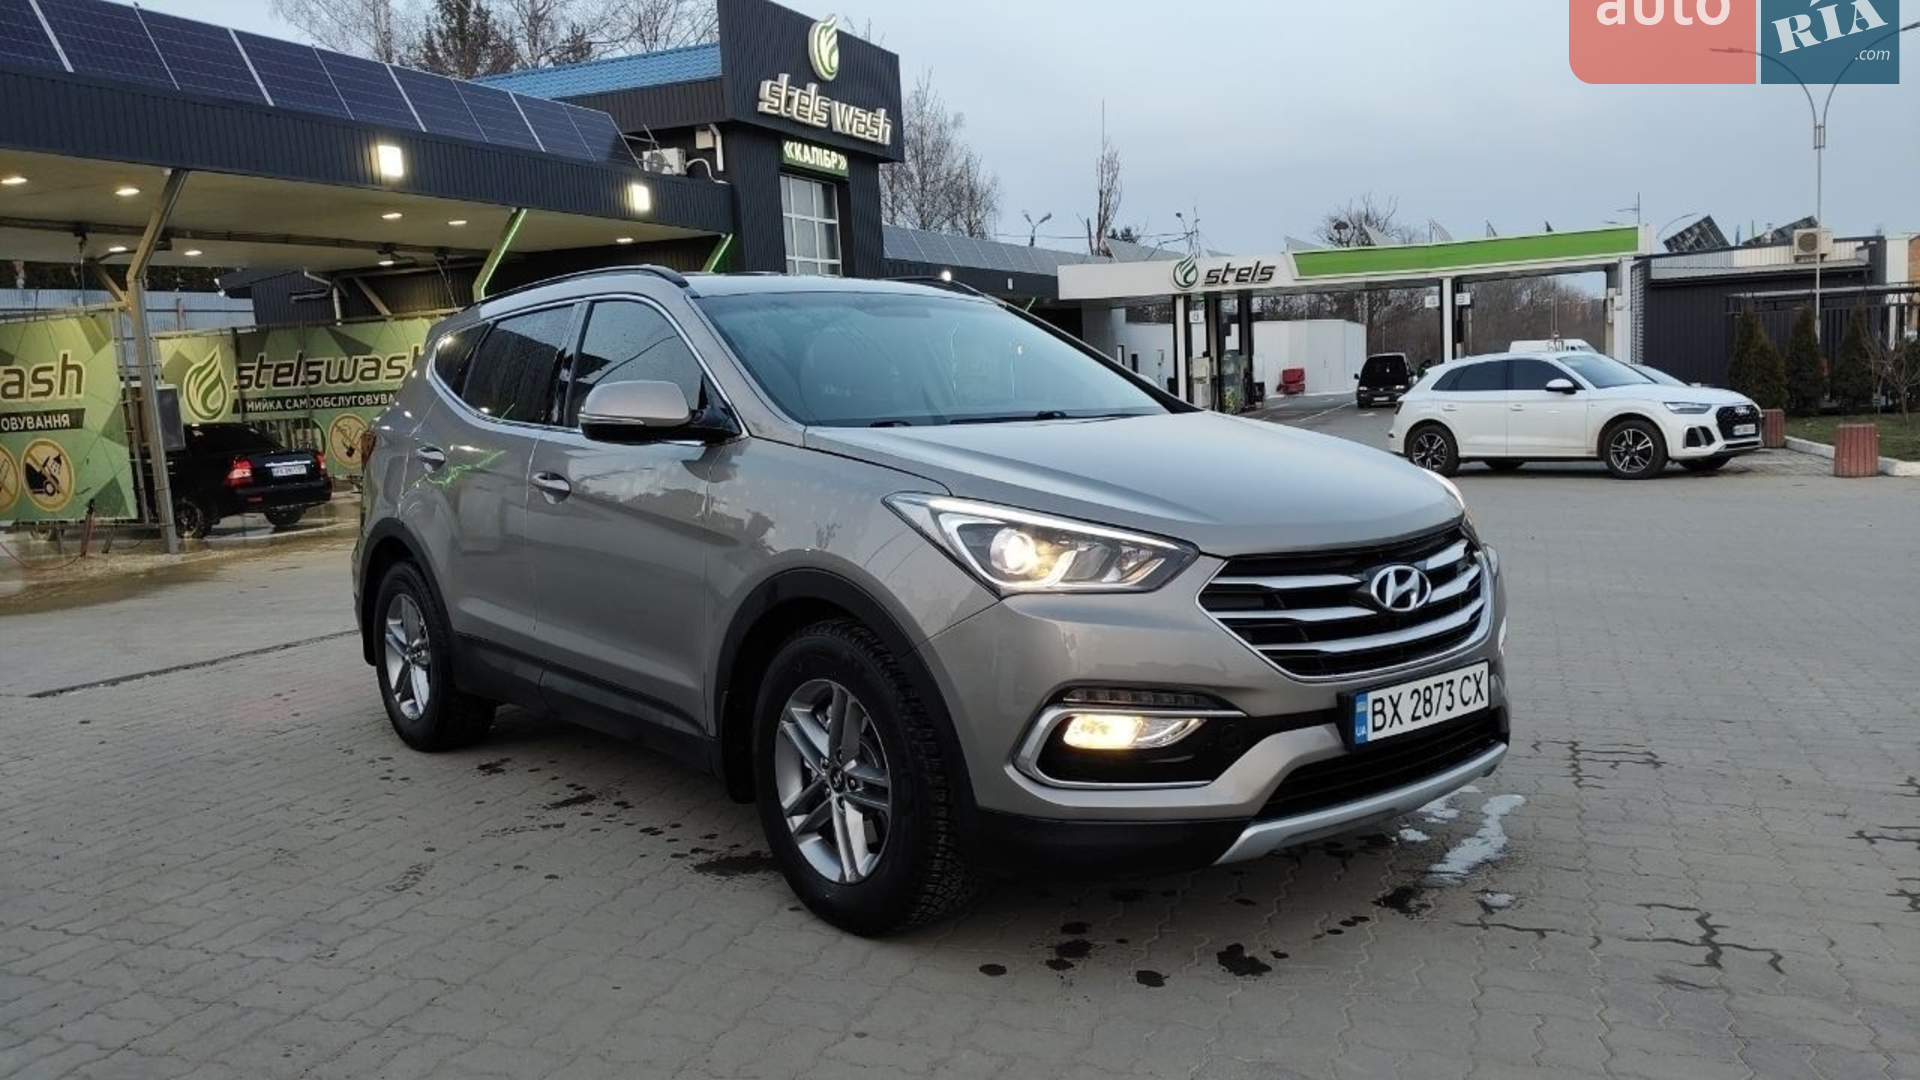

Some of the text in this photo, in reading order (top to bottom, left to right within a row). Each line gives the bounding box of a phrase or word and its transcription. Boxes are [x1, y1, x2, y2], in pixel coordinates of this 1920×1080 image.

[757, 73, 893, 146] stels wash
[1203, 260, 1277, 285] stels
[246, 399, 283, 412] МИЙКА
[1410, 679, 1455, 723] 2873
